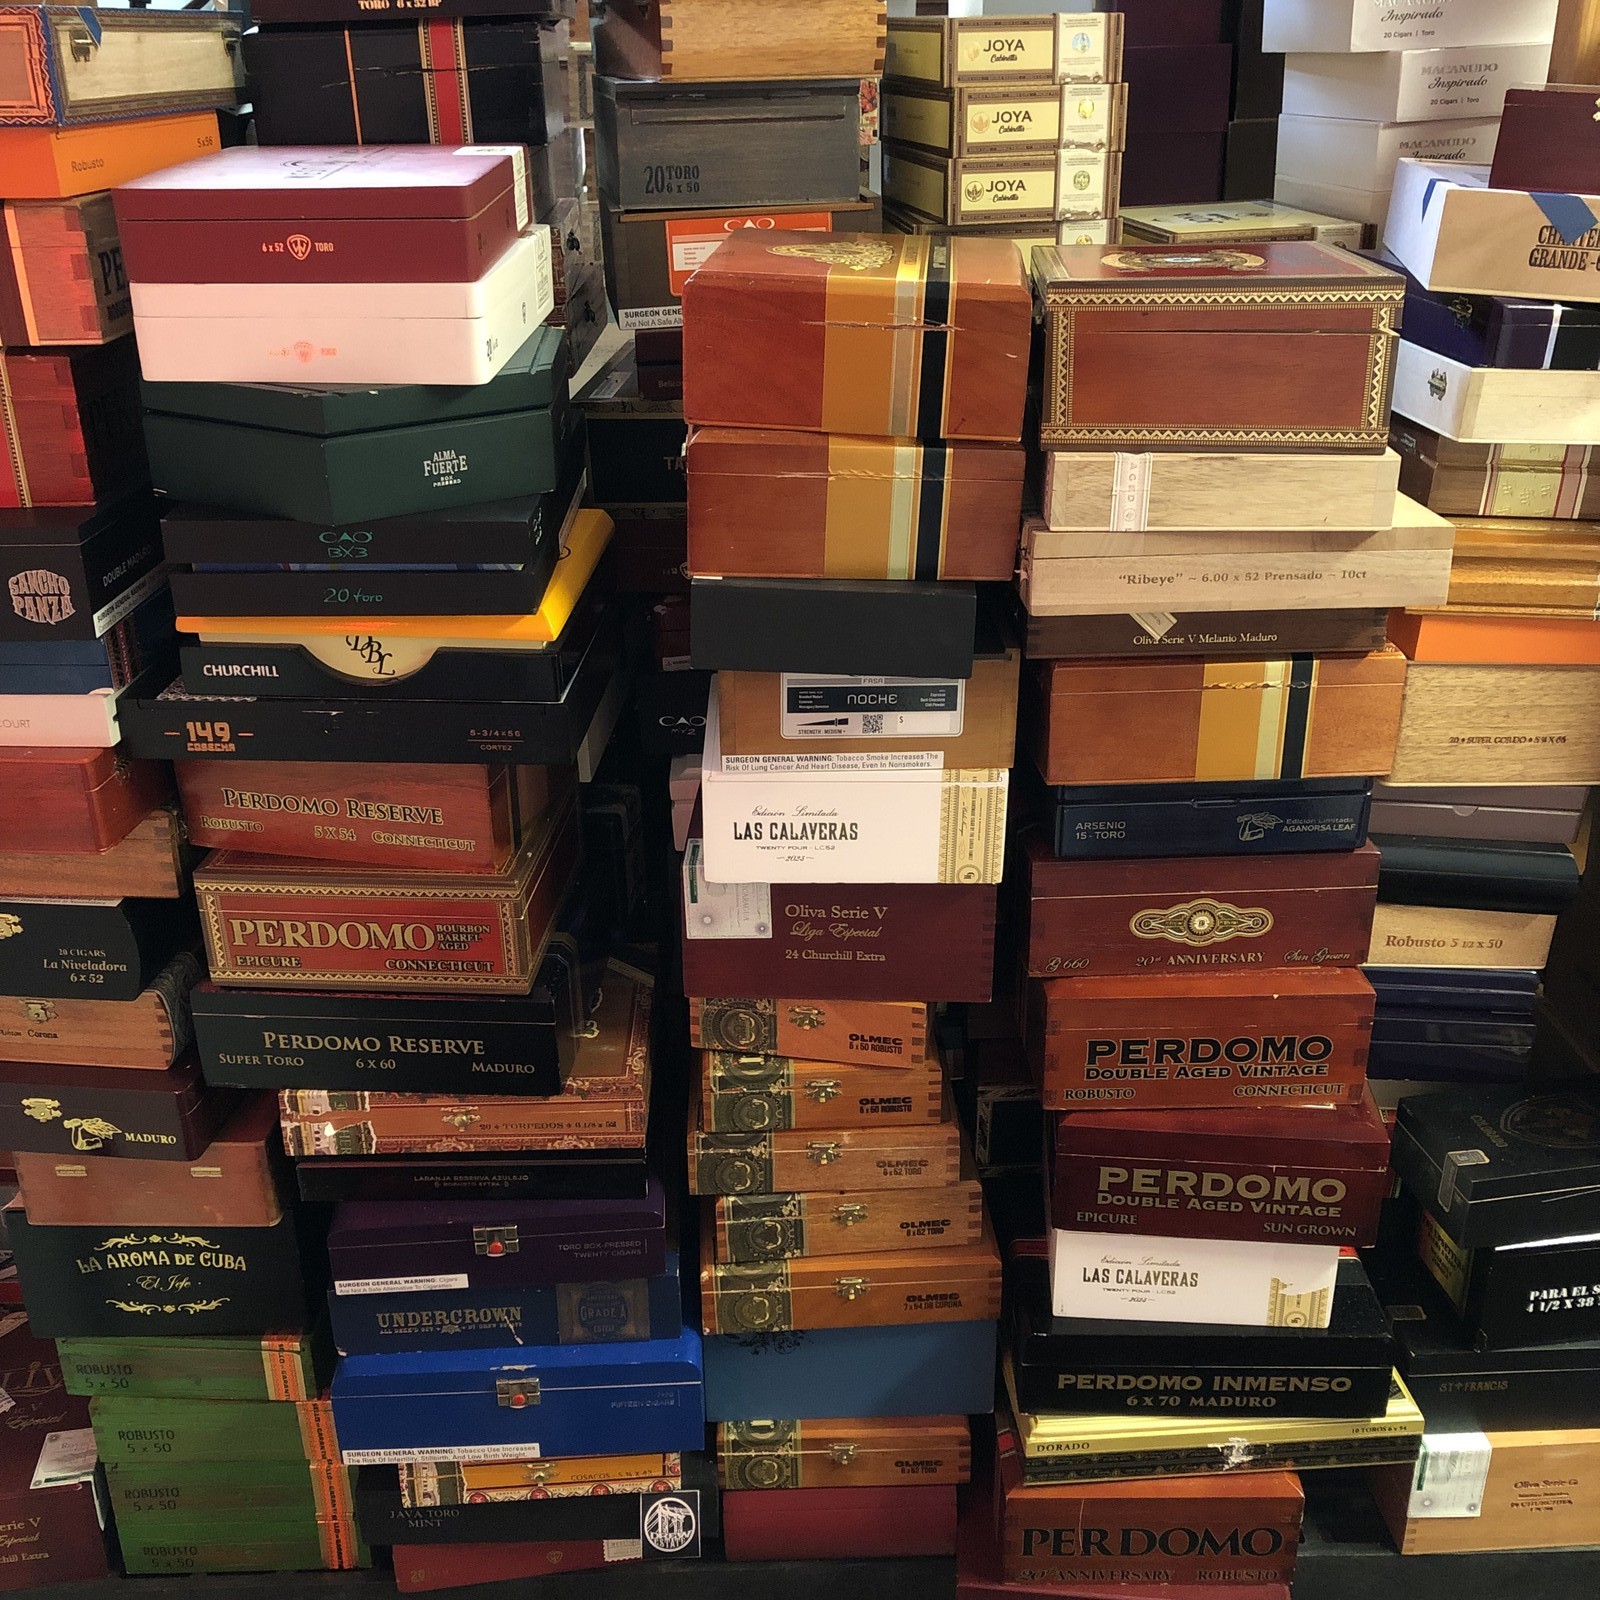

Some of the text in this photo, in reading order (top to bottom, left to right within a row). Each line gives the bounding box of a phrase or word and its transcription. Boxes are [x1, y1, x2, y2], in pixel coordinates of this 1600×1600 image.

[1381, 7, 1443, 24] Inspirado
[1393, 30, 1412, 39] Cigars
[983, 39, 1025, 52] JOYA
[1421, 63, 1498, 75] MACANUDO
[1428, 75, 1488, 92] Inspirado
[992, 111, 1032, 124] JOYA
[1400, 137, 1476, 149] MACANUDO
[71, 157, 105, 173] Robusto
[666, 165, 700, 179] TORO
[644, 166, 665, 193] 20
[986, 180, 1026, 192] JOYA
[686, 182, 700, 193] 50
[314, 242, 334, 253] TORO
[1529, 248, 1588, 270] GRANDE
[624, 309, 660, 318] SURGEON
[433, 450, 457, 463] ALMA
[423, 455, 468, 477] FUERTE
[319, 532, 373, 544] CAO
[328, 547, 369, 558] BX3
[8, 569, 71, 597] SANCHO
[1201, 570, 1367, 583] 6.00 52 Prensado 10ct
[324, 588, 349, 603] 20
[13, 596, 77, 625] PANZA
[1161, 632, 1278, 646] Serie Melanio Maduro
[203, 664, 279, 678] CHURCHILL
[186, 721, 231, 742] 149
[187, 743, 236, 752] COSECHA
[725, 756, 761, 764] SURGEON
[762, 755, 795, 763] GENERAL
[796, 755, 834, 763] WARNING:
[836, 754, 865, 762] Tobacco
[890, 753, 925, 761] Increases
[751, 764, 768, 772] Lung
[769, 763, 794, 771] Cancer
[811, 762, 830, 770] Heart
[831, 762, 860, 770] Disease,
[861, 761, 878, 769] Even
[888, 761, 932, 769] Nonsmokers.
[221, 787, 443, 825] PERDOMO RESERVE
[792, 805, 839, 817] Limitada
[733, 822, 859, 841] LAS CALAVERAS
[1075, 821, 1126, 831] ARSENIO
[1282, 823, 1357, 833] AGANORSA LEAF
[200, 816, 475, 852] ROBUSTO 54 CONNECTICUT
[1094, 830, 1126, 840] TORO
[784, 904, 870, 920] Oliva Serie
[229, 919, 435, 951] PERDOMO
[435, 924, 491, 934] BOURBON
[828, 922, 882, 941] Especial
[436, 932, 482, 943] BARREL
[1386, 935, 1503, 949] Robusto 50
[438, 941, 470, 951] AGED
[69, 949, 106, 958] CIGARS
[785, 949, 886, 962] 24 Churchill Extra
[1166, 952, 1265, 966] ANNIVERSARY
[43, 958, 127, 972] La Niveladora
[236, 954, 301, 968] EPICURE
[385, 958, 494, 972] CONNECTICUT
[88, 974, 104, 983] 52
[262, 1031, 485, 1055] PERDOMO RESERVE
[849, 1033, 903, 1046] OLMEC
[1084, 1035, 1333, 1065] PERDOMO
[219, 1053, 535, 1075] SUPER TORO 60 MADURO
[1084, 1064, 1328, 1081] DOUBLE AGED VINTAGE
[1064, 1088, 1135, 1100] ROBUSTO
[1233, 1084, 1344, 1097] CONNECTICUT
[859, 1097, 912, 1105] OLMEC
[881, 1104, 912, 1113] ROBUSTO
[125, 1132, 177, 1145] MADURO
[876, 1160, 928, 1168] OLMEC
[1098, 1166, 1346, 1203] PERDOMO
[1097, 1192, 1342, 1218] DOUBLE AGED VINTAGE
[900, 1219, 951, 1229] OLMEC
[1076, 1211, 1137, 1225] EPICURE
[1263, 1222, 1357, 1238] SUN GROWN
[573, 1251, 609, 1259] TWENTY
[76, 1250, 248, 1274] LA AROMA DE CUBA
[1082, 1267, 1198, 1288] LAS CALAVERAS
[906, 1293, 960, 1302] OLMEC
[1530, 1288, 1568, 1301] PARA
[376, 1306, 522, 1329] UNDERCROWN
[76, 1364, 133, 1376] ROBUSTO
[109, 1378, 129, 1389] 50
[1058, 1374, 1352, 1392] PERDOMO INMENSO
[1158, 1396, 1276, 1408] 70 MADURO
[118, 1430, 175, 1441] ROBUSTO
[1036, 1442, 1090, 1452] DORADO
[482, 1451, 499, 1459] Birth
[124, 1487, 180, 1499] ROBUSTO
[390, 1509, 460, 1519] JAVA TORO
[408, 1519, 443, 1528] MINT
[1020, 1527, 1283, 1557] PERDOMO
[1058, 1568, 1280, 1581] ANNIVERSARY ROBUSTO
